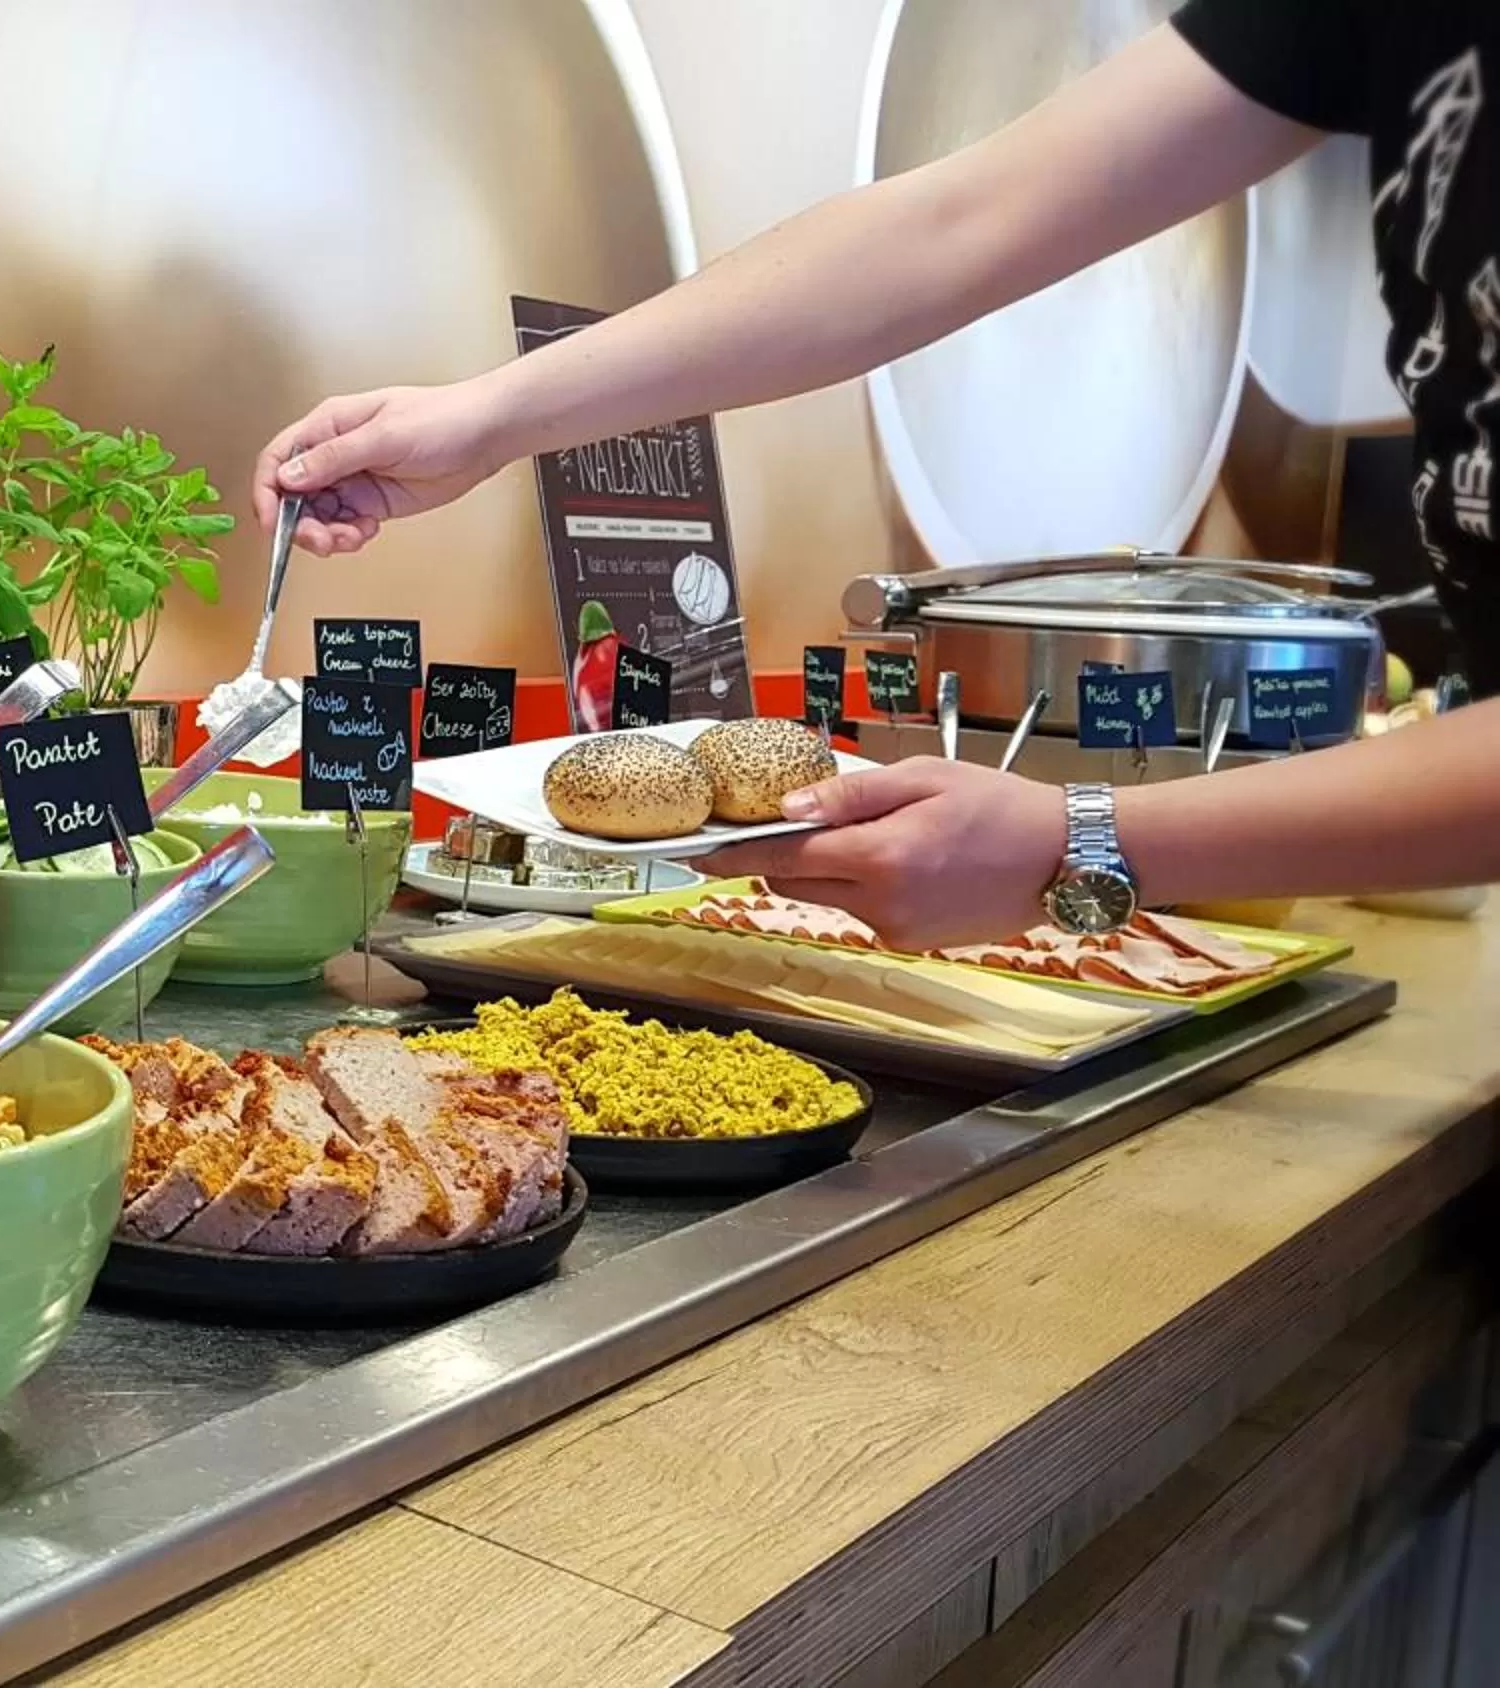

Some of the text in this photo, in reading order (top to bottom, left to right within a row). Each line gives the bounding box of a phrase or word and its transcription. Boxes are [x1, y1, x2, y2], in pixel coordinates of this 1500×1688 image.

[304, 687, 348, 715] Pasta
[430, 676, 455, 699] Ser
[421, 711, 477, 740] Cheese
[5, 730, 102, 775] Pasztet
